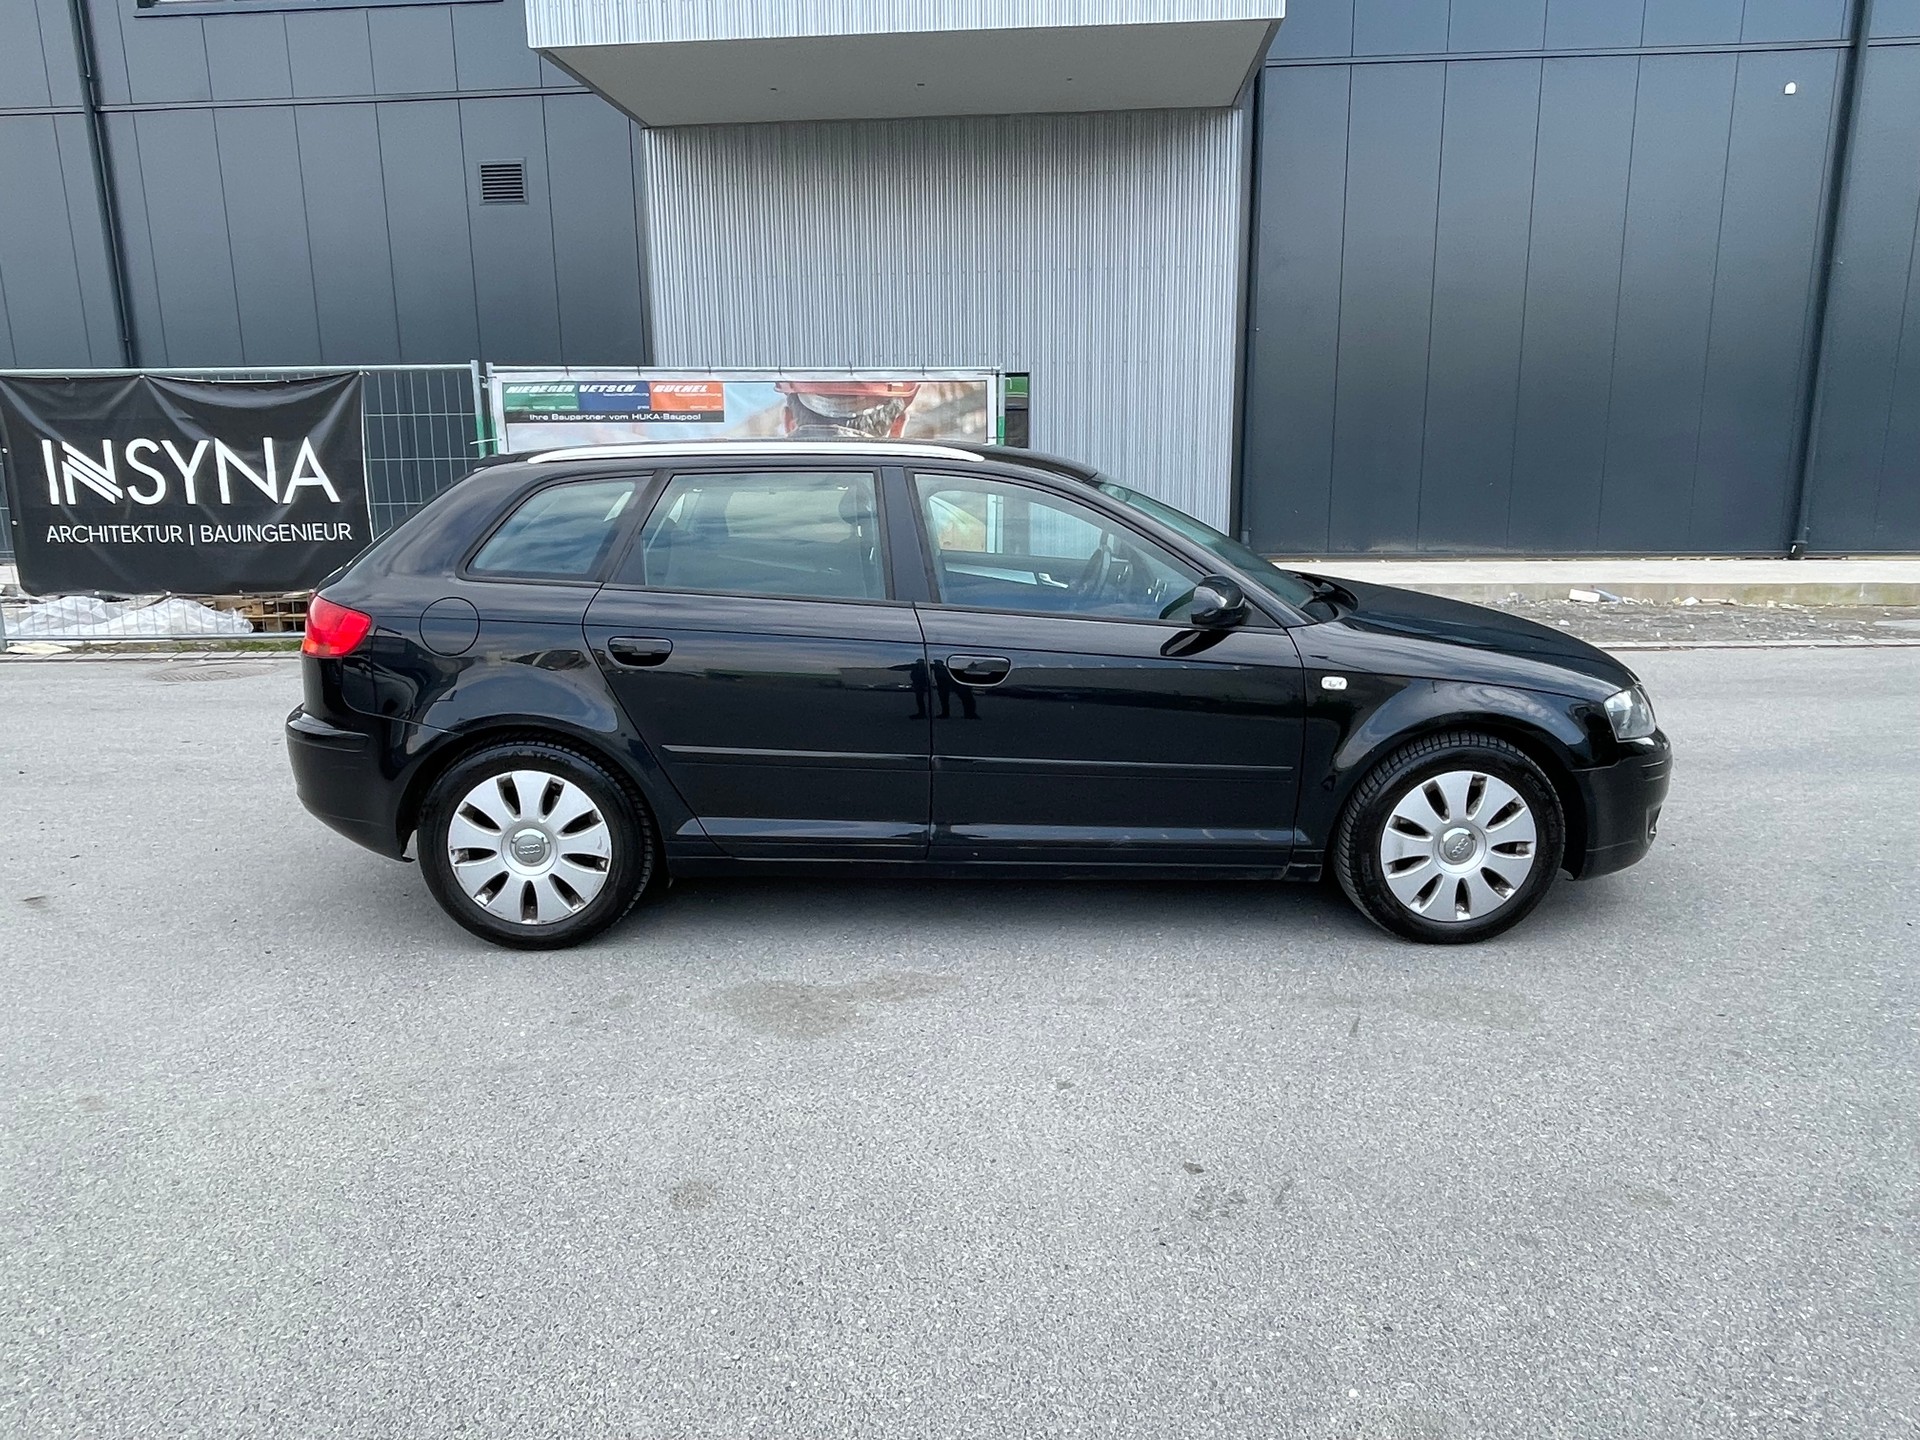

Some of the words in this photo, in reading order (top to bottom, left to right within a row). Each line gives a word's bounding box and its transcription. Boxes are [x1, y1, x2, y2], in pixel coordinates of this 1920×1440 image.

[578, 384, 637, 393] VETSCH
[529, 413, 549, 421] Ihre
[551, 413, 606, 422] Baupartner
[631, 413, 702, 422] HUKA-Baupool
[41, 436, 341, 505] INSYNA
[46, 524, 184, 544] ARCHITEKTUR
[200, 522, 354, 544] BAUINGENIEUR
